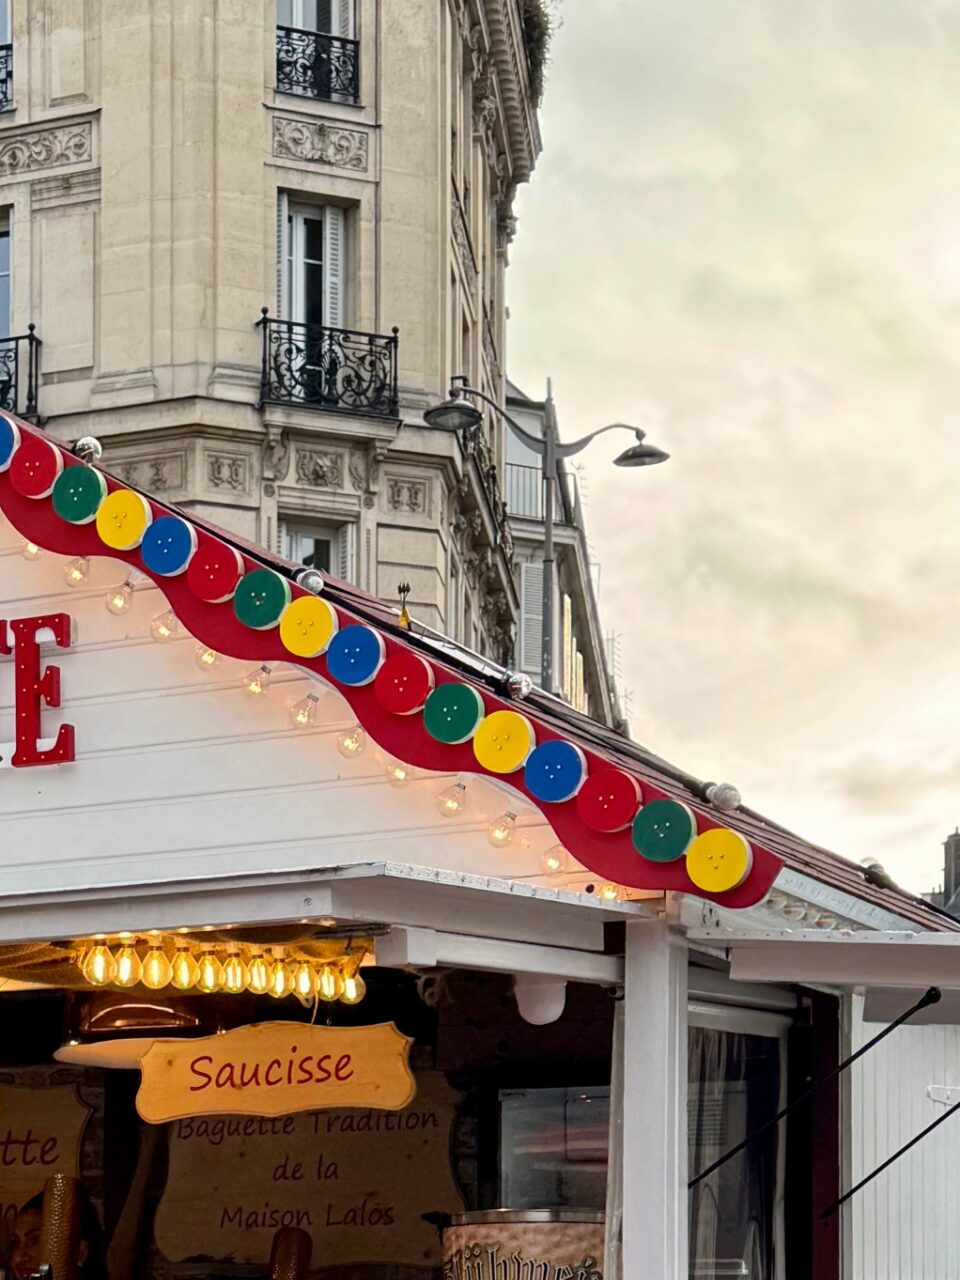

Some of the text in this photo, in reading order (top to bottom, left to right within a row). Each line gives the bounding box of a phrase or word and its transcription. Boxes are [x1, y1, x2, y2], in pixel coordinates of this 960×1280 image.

[189, 1045, 355, 1092] Saucisse
[308, 1109, 440, 1135] Tradition
[272, 1154, 339, 1181] de la
[219, 1203, 312, 1230] Maison
